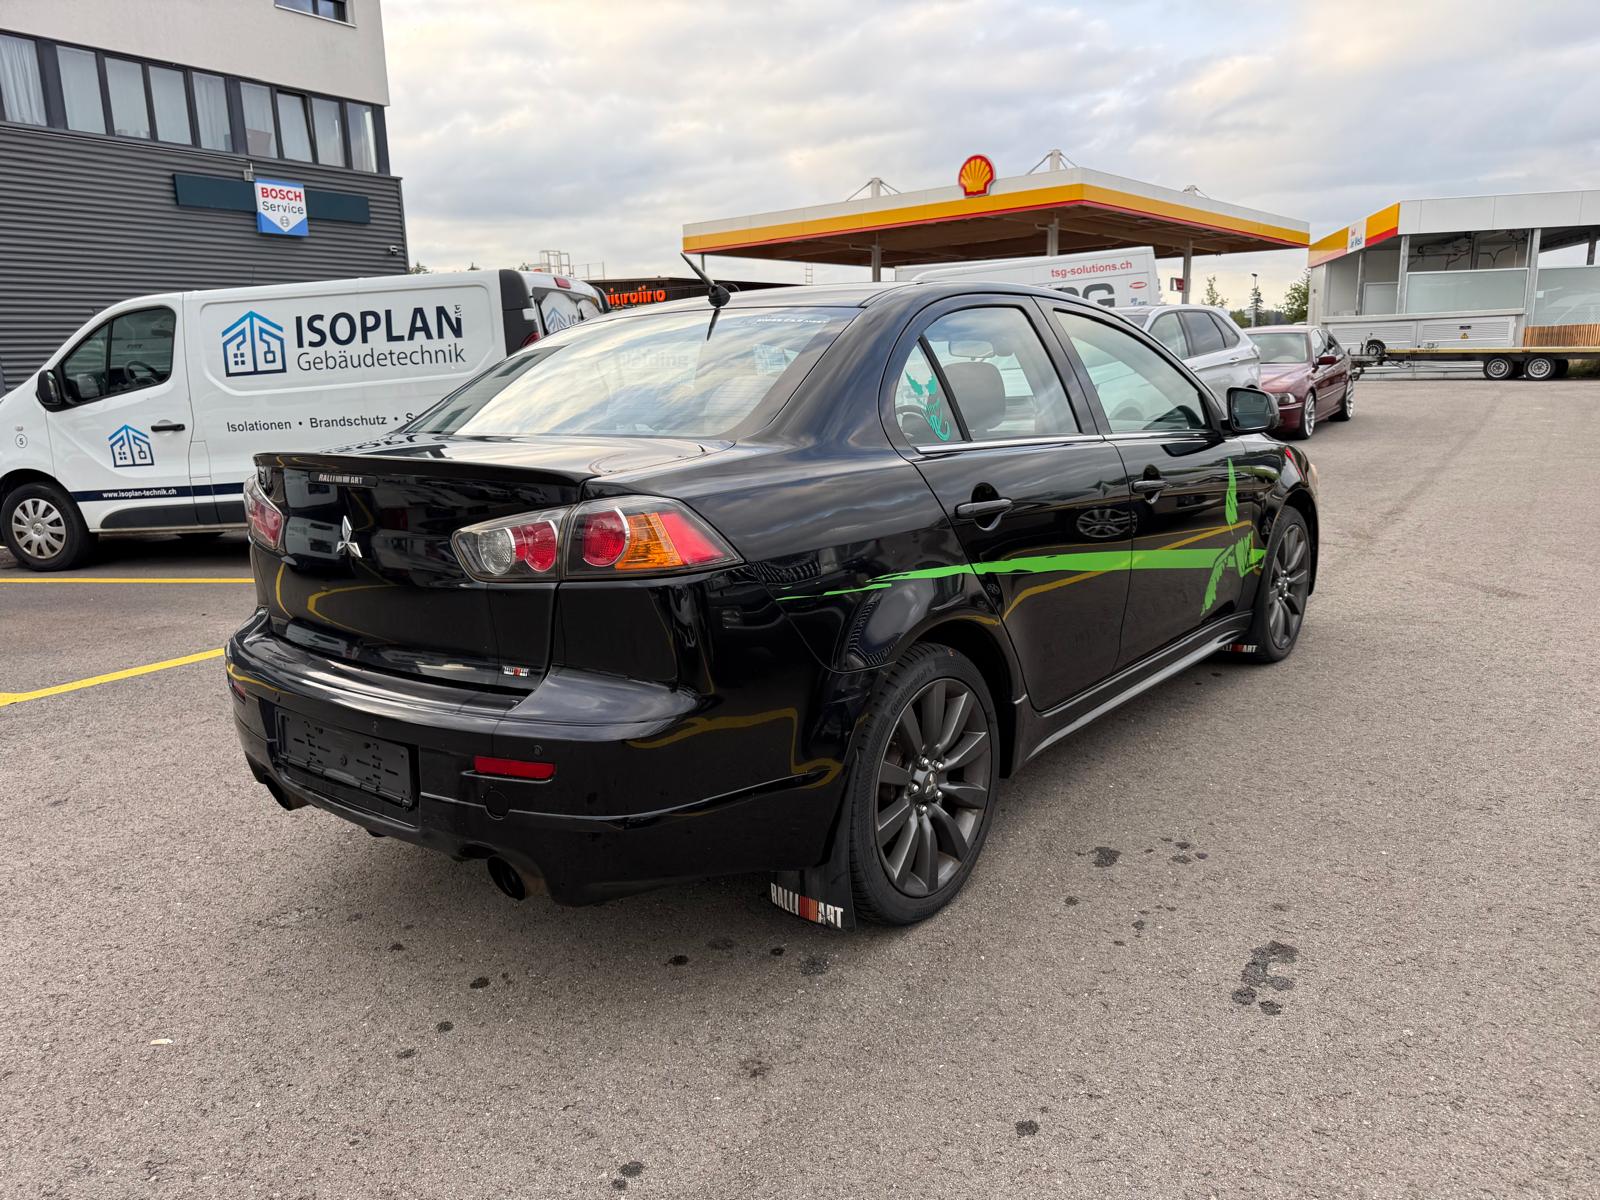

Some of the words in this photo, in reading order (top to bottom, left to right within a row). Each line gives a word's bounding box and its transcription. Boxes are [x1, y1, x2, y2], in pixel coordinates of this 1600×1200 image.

[261, 187, 302, 201] BOSCH
[262, 201, 304, 215] Service
[1051, 261, 1133, 278] tsg-solutions.ch
[296, 306, 463, 348] ISOPLAN
[297, 343, 466, 371] Gebäudetechnik
[227, 419, 292, 432] Isolationen
[309, 415, 388, 428] Brandschutz
[102, 488, 177, 499] www.isoplan-technik.ch
